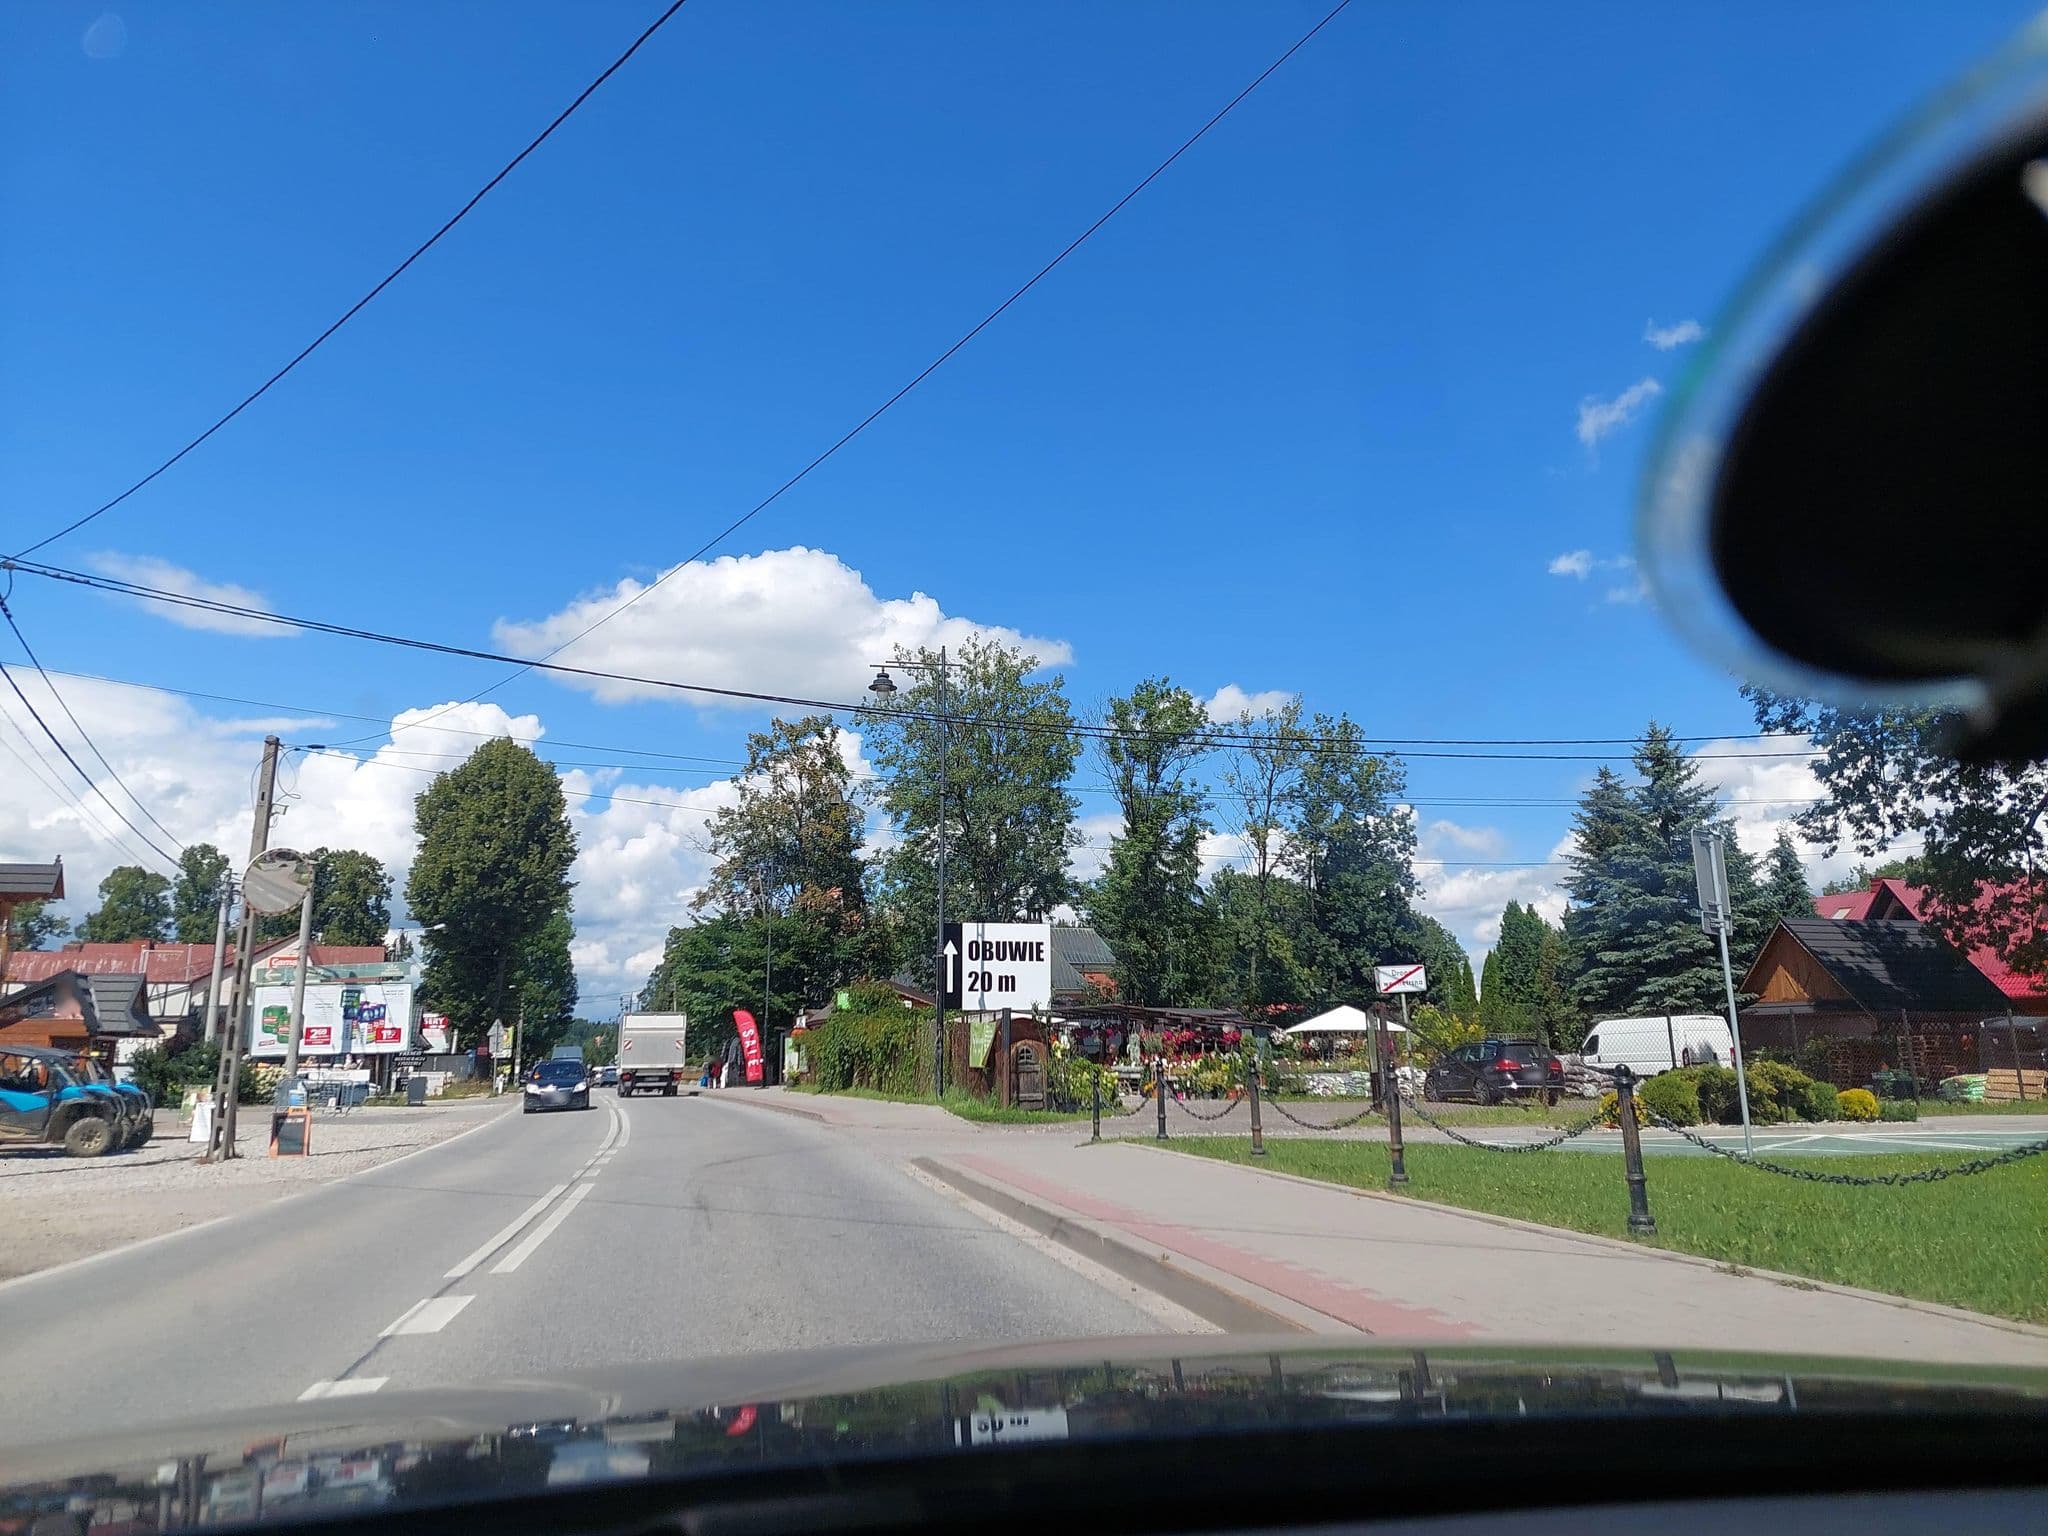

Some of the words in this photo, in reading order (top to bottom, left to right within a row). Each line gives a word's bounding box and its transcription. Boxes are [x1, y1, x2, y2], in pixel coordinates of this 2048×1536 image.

[968, 941, 1044, 961] OBUWIE
[968, 971, 993, 992] 20
[998, 974, 1016, 992] m
[1391, 969, 1411, 977] Dro
[743, 1029, 758, 1066] SALE
